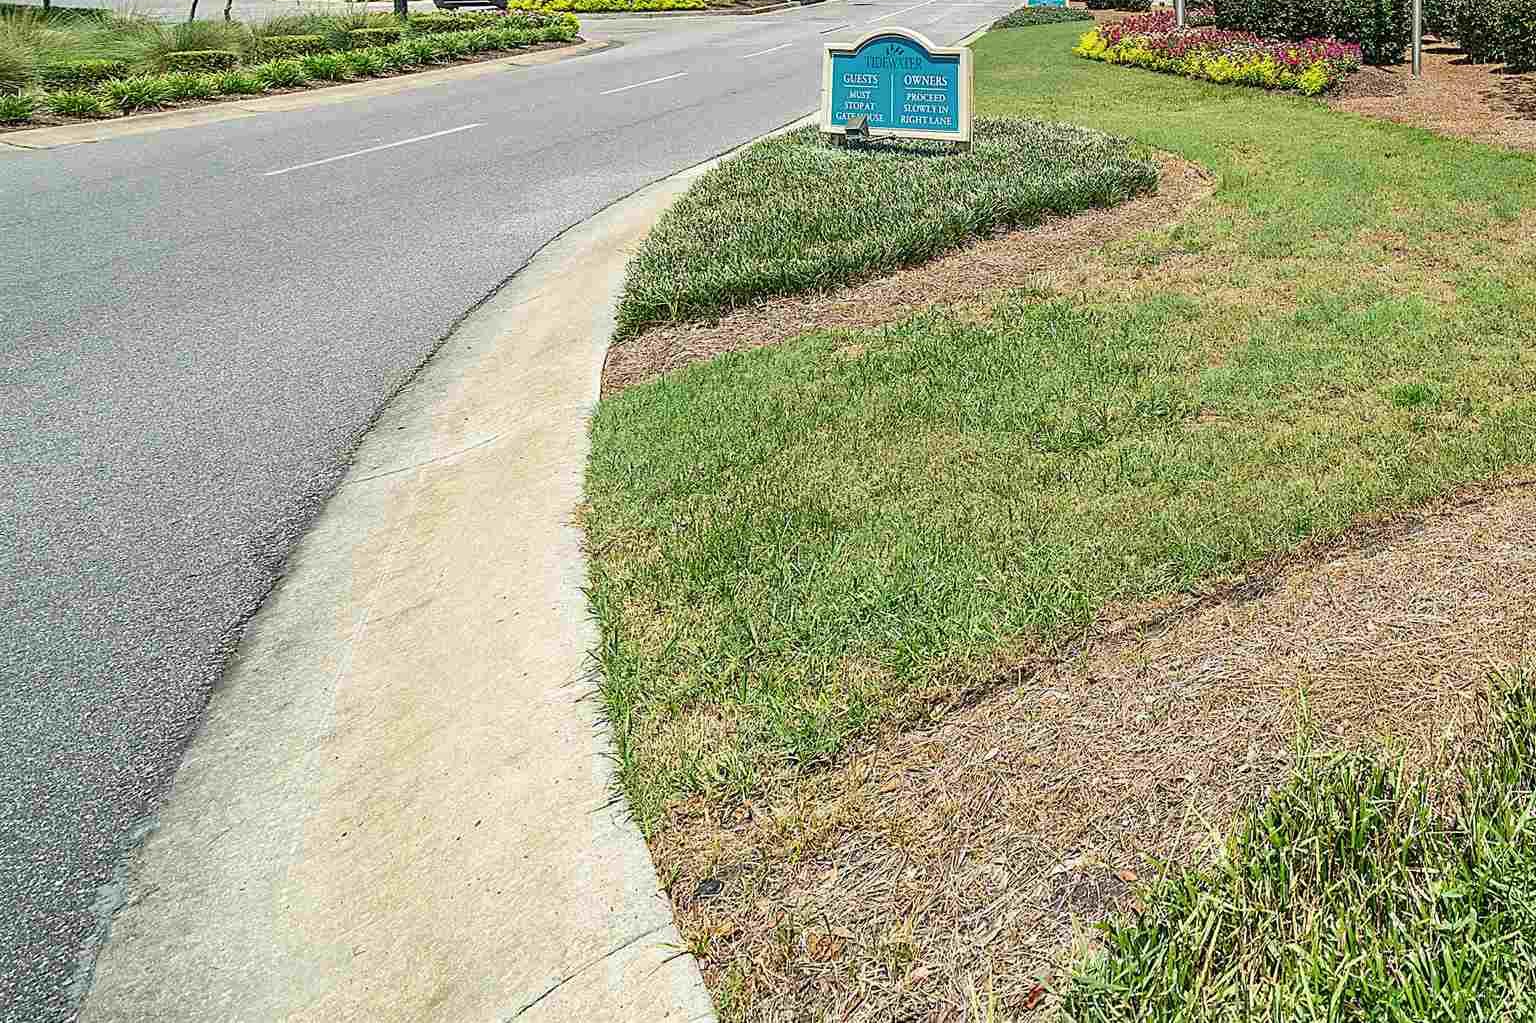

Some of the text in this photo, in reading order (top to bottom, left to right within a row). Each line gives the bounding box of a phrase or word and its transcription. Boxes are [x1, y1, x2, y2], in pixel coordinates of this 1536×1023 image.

[866, 55, 922, 70] TIDEWATER
[843, 73, 879, 84] GUESTS
[904, 74, 947, 86] OWNERS
[848, 89, 871, 99] MUST
[906, 93, 946, 102] PROCEED
[845, 101, 875, 111] STOP AT
[904, 104, 949, 114] SLOWLY IN
[900, 115, 952, 126] RIGHT LANE
